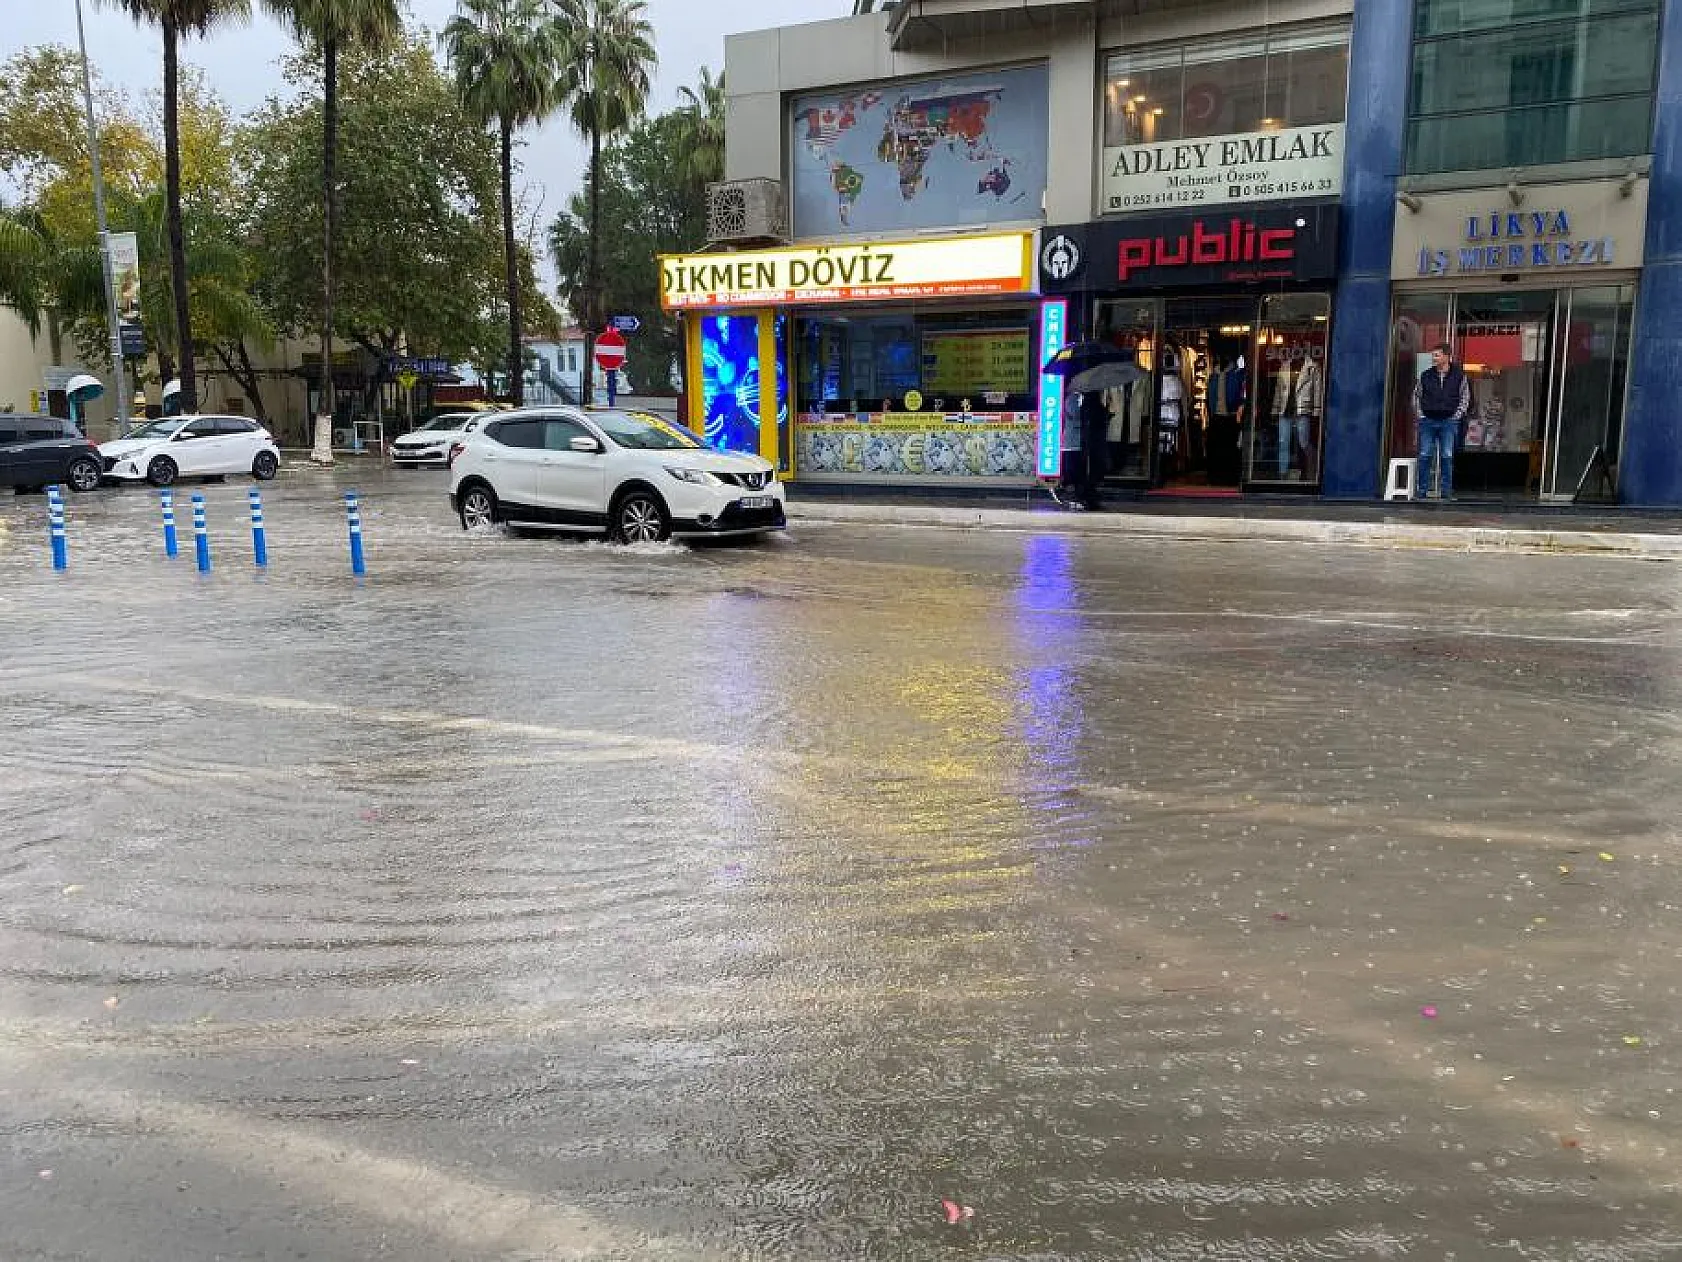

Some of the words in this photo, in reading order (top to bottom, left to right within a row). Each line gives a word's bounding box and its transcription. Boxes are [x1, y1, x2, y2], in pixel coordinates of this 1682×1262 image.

[1111, 143, 1213, 177] ADLEY
[1219, 130, 1334, 166] EMLAK
[1227, 168, 1268, 182] Özsoy
[1277, 181, 1298, 192] 415
[1301, 180, 1315, 191] 66
[1467, 208, 1569, 241] LİKYA
[789, 246, 895, 287] DÖVİZ
[1118, 218, 1296, 281] public
